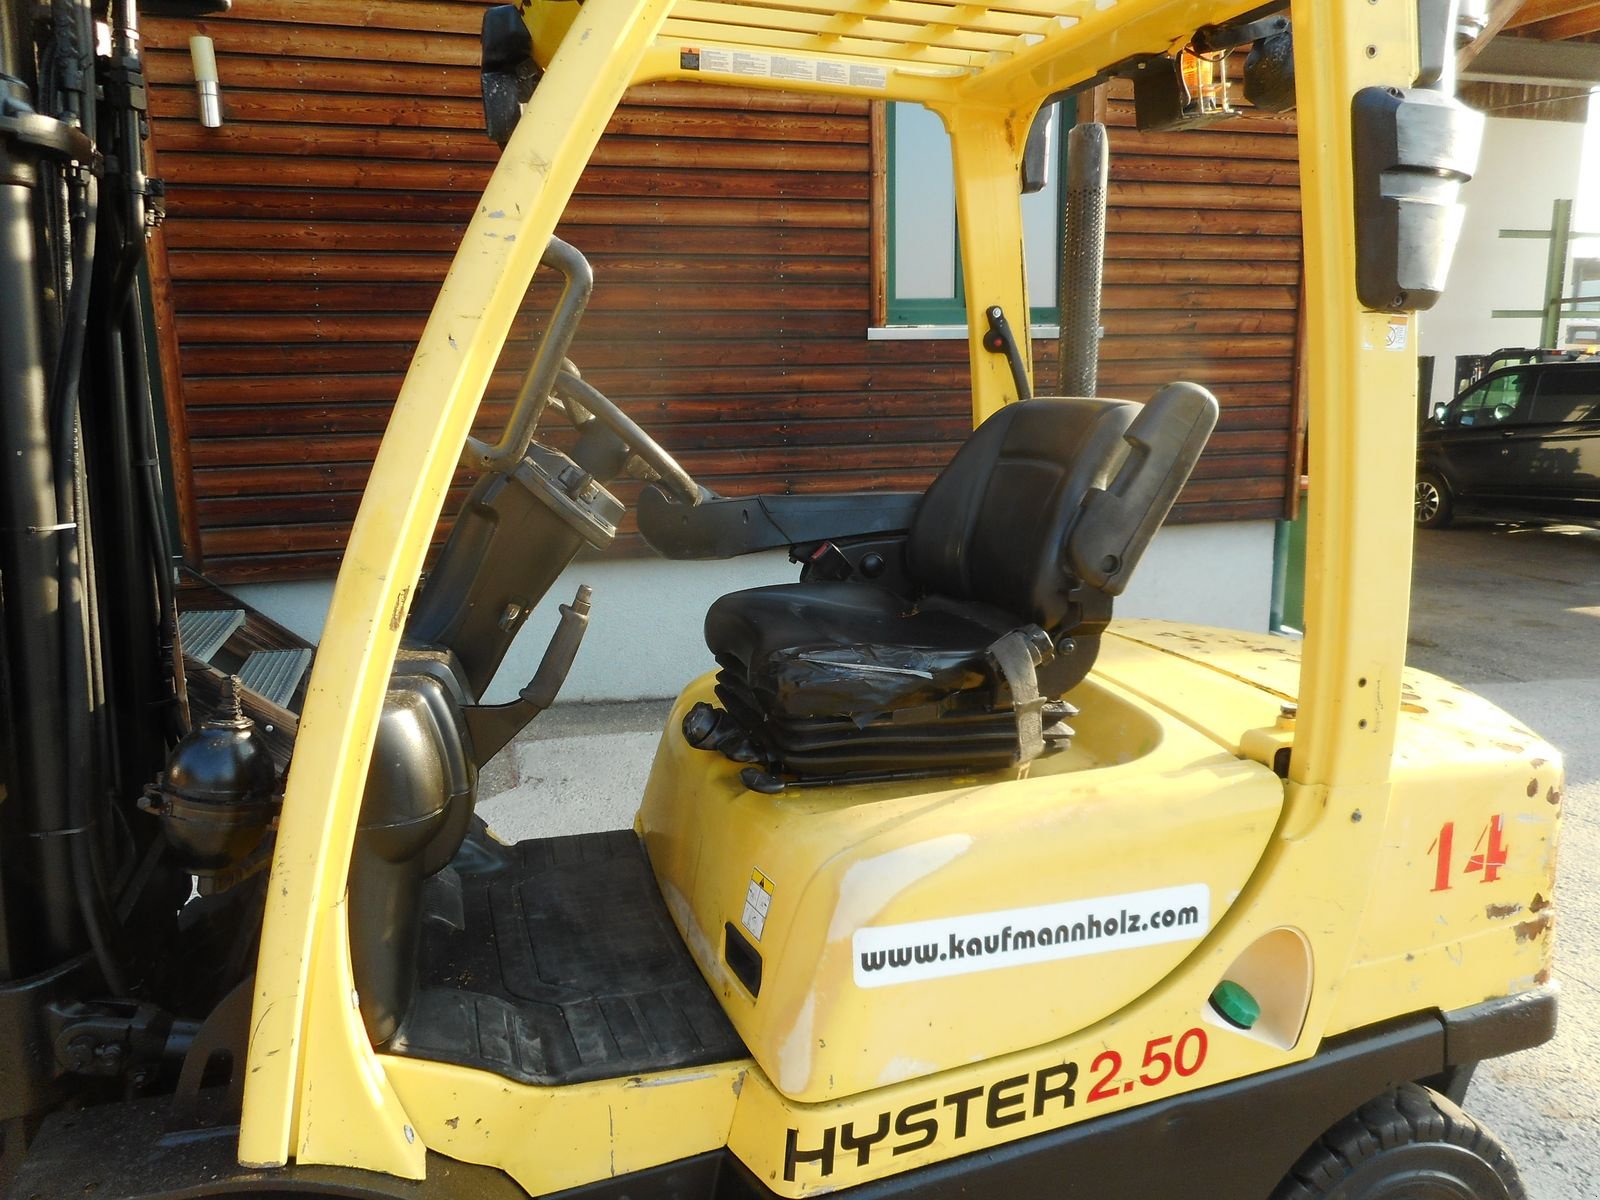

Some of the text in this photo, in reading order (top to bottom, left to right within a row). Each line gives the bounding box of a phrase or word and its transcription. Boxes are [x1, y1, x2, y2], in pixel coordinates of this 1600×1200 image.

[1427, 815, 1508, 892] 14
[861, 906, 1198, 972] www.kaufmannholz.com
[783, 1027, 1208, 1182] HYSTER 2.50
